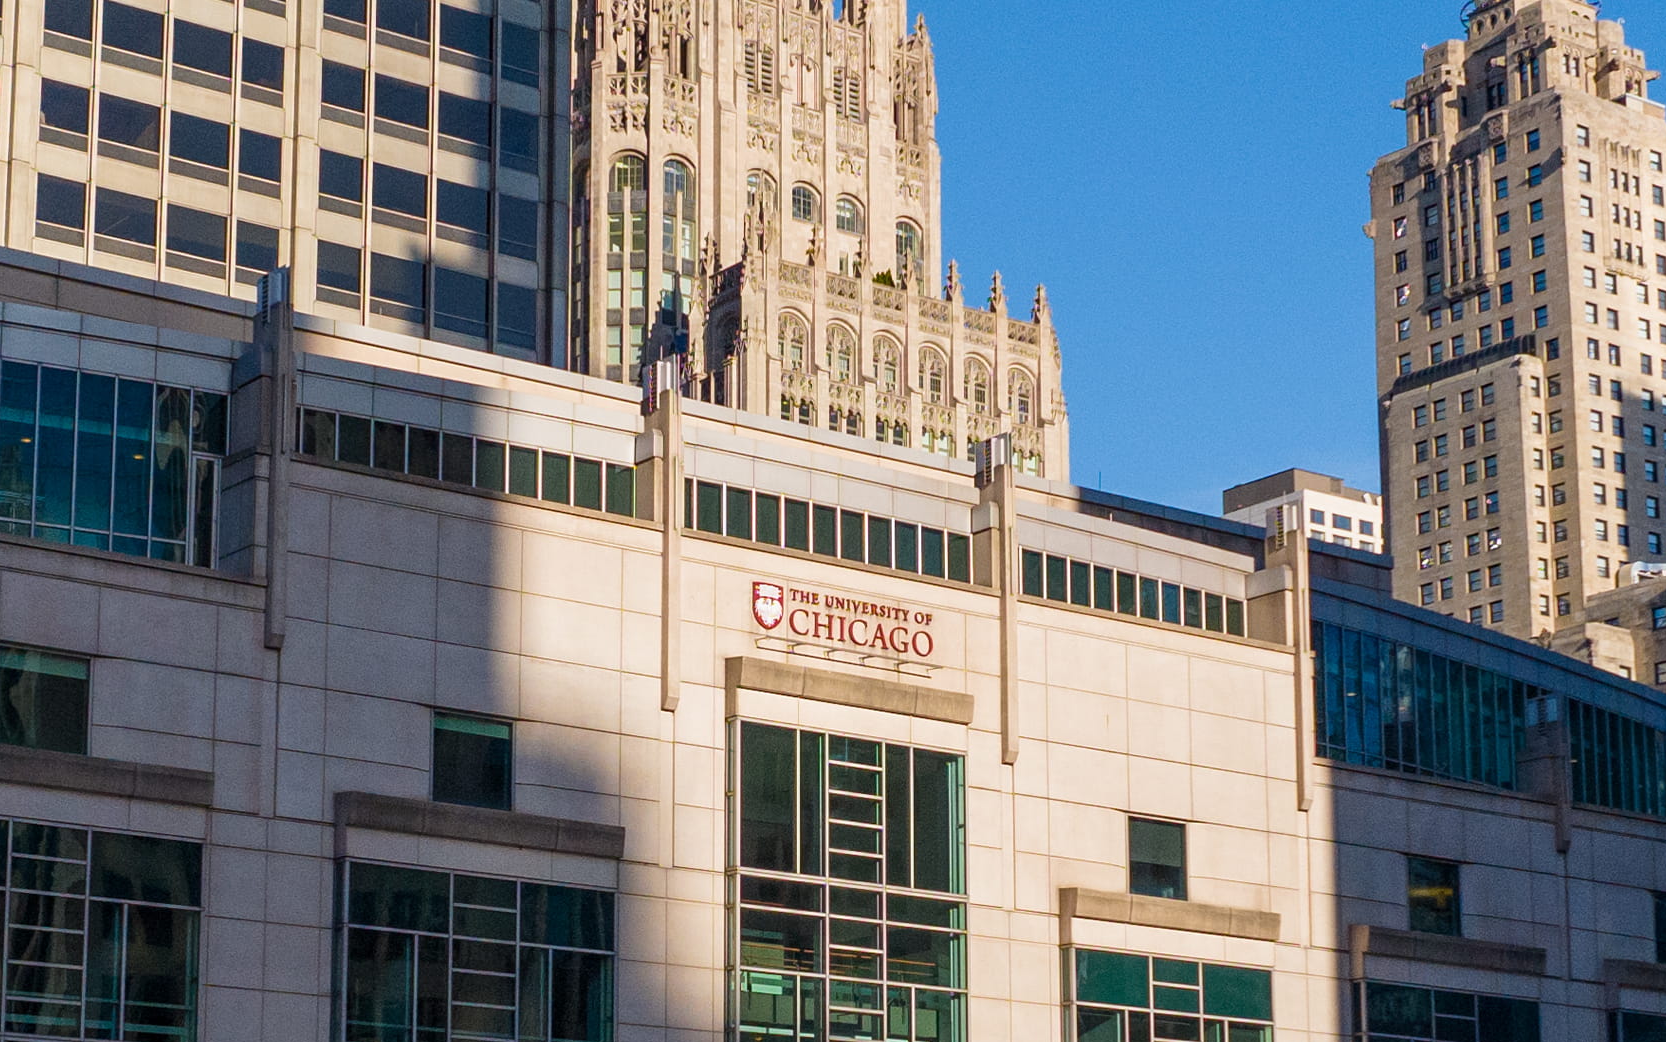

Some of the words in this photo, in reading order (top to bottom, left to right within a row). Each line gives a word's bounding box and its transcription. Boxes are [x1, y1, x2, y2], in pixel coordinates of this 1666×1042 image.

[790, 588, 819, 606] THE
[824, 595, 910, 622] UNIVERSITY
[914, 611, 933, 626] OF
[788, 608, 934, 657] CHICAGO
